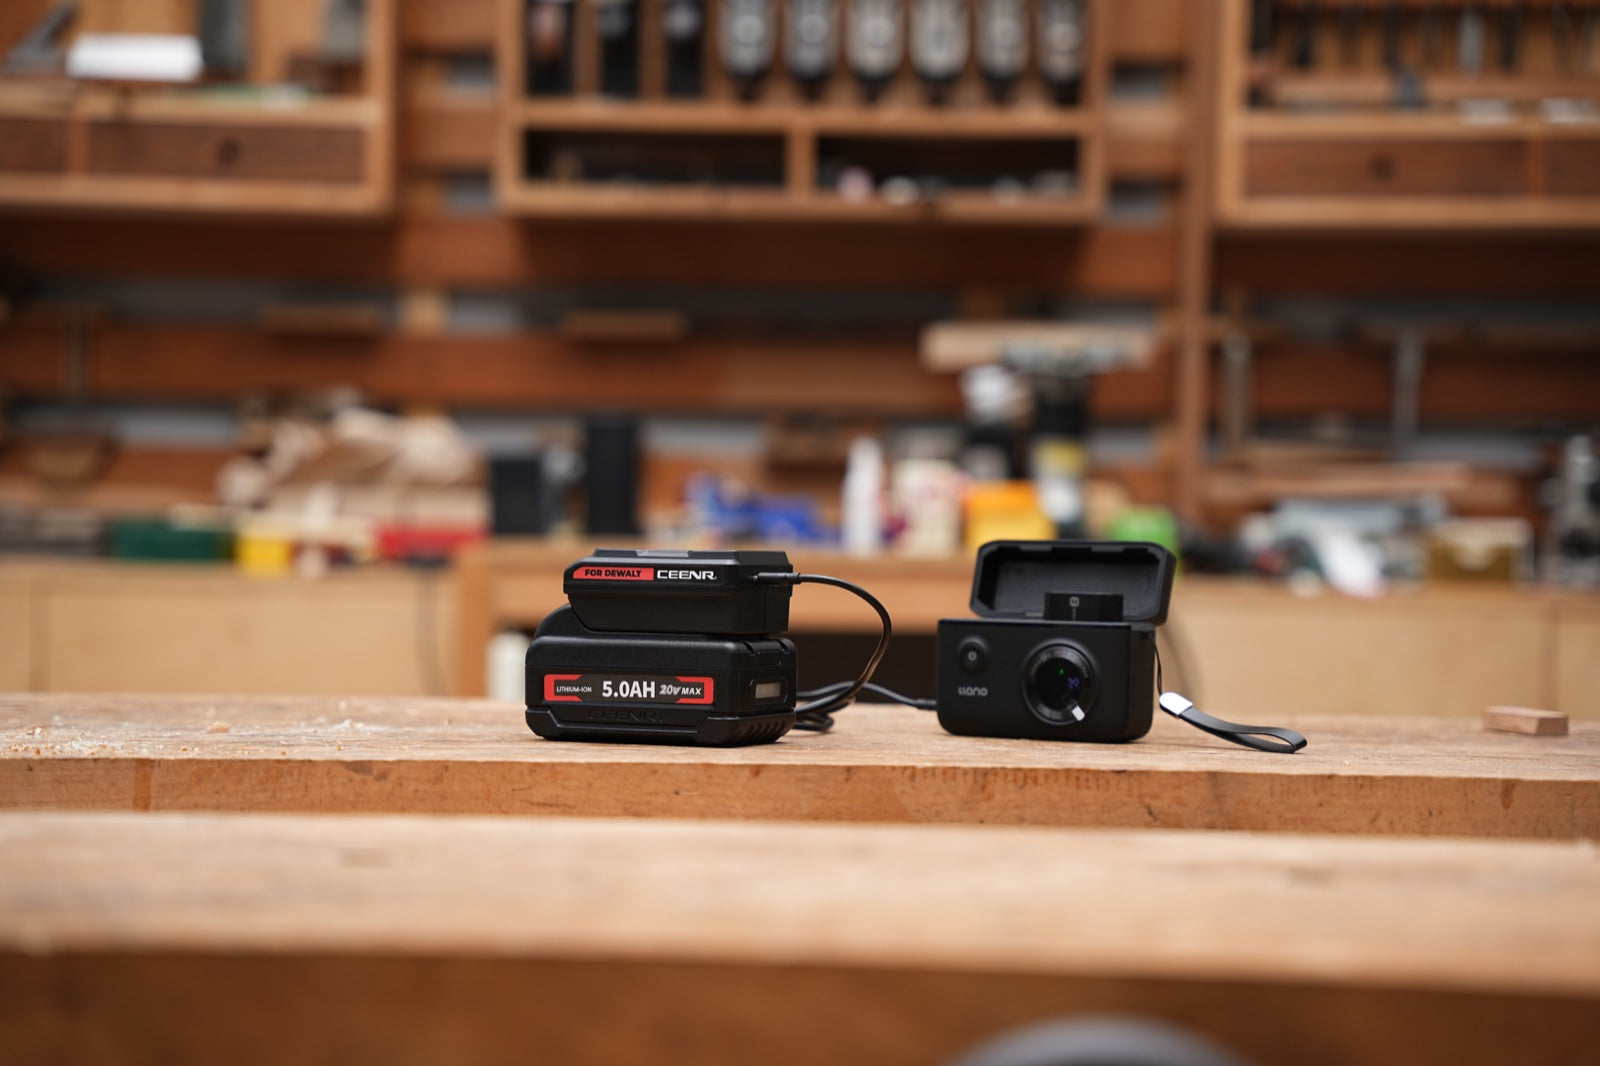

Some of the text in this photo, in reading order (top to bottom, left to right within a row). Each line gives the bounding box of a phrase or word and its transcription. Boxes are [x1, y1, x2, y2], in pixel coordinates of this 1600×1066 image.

[584, 568, 642, 578] FOR DEWALT
[556, 685, 592, 694] LITHIUM-ION
[601, 680, 656, 699] 5.0AH
[681, 687, 702, 697] MAX
